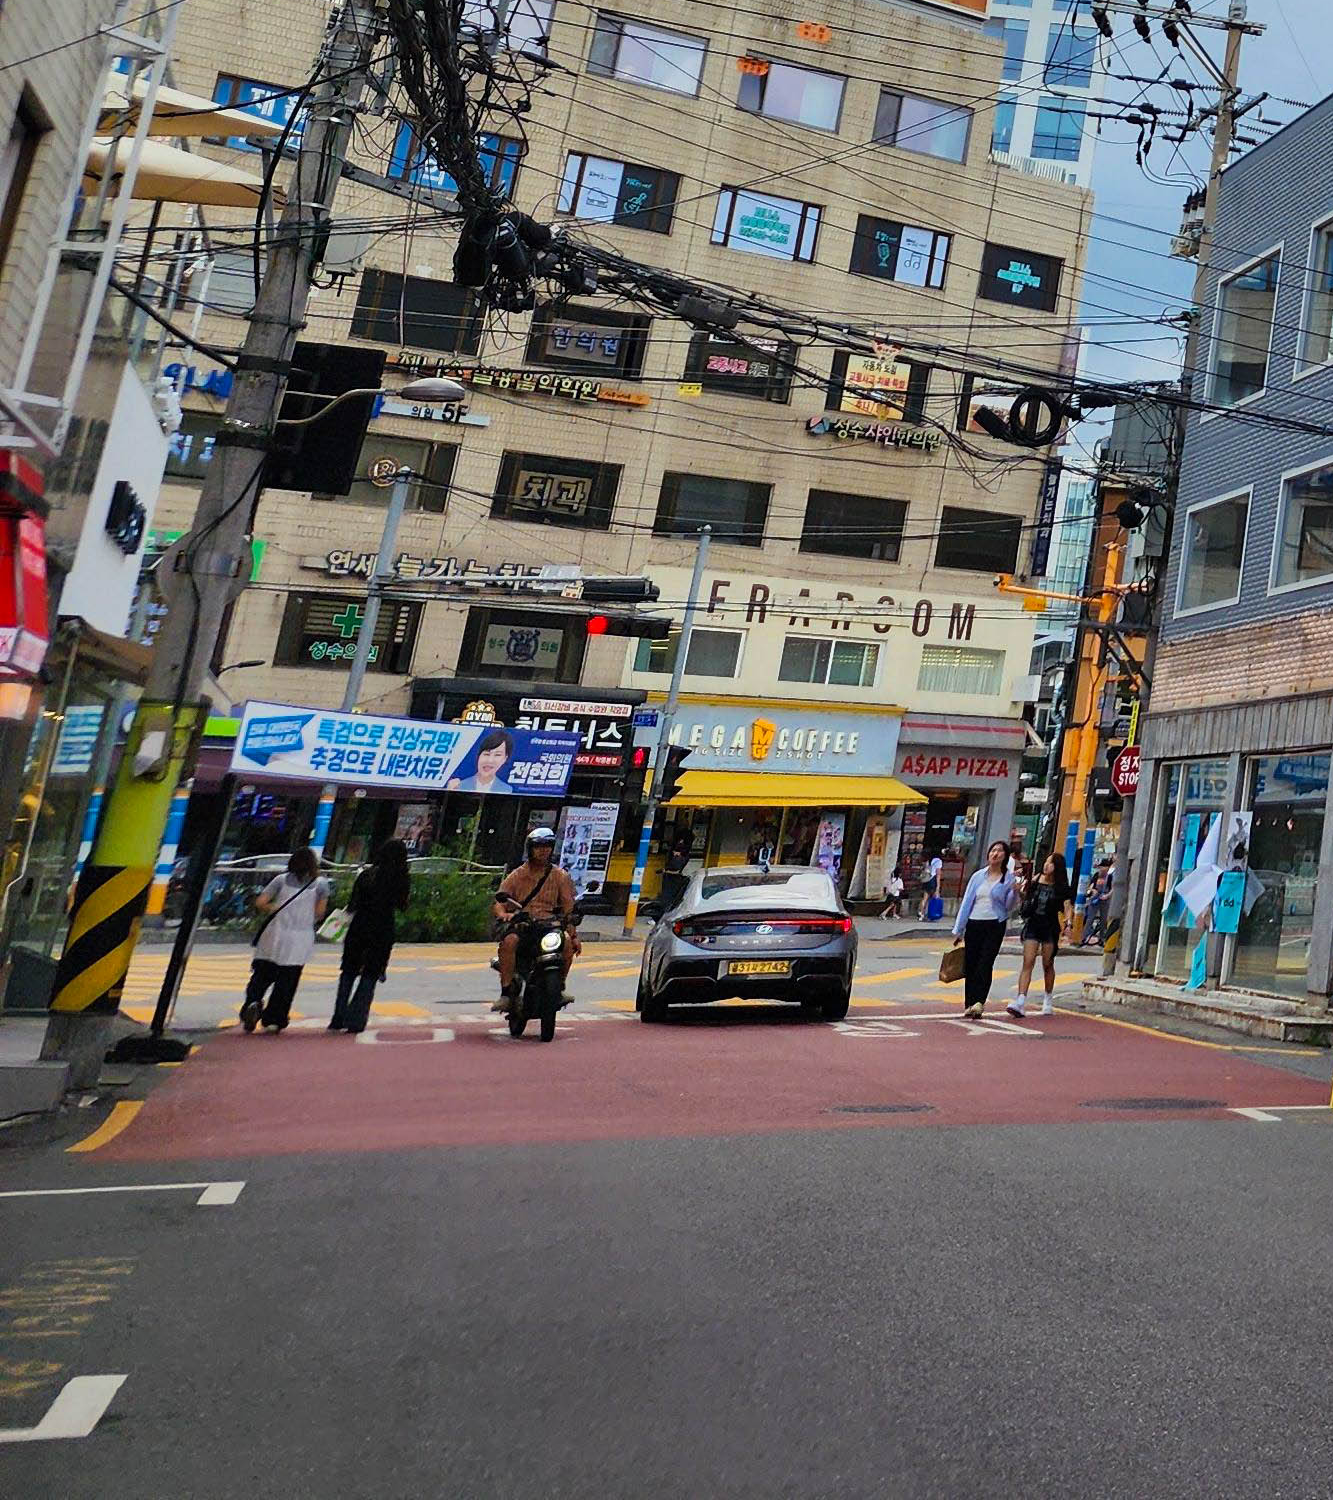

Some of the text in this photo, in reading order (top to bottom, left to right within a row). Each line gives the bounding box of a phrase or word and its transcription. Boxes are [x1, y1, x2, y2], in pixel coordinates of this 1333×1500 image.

[552, 326, 619, 357] 한의원
[441, 403, 469, 424] 5F
[523, 476, 587, 513] 치과
[317, 718, 385, 748] 특검으로
[386, 726, 461, 754] 진상규명!
[668, 722, 860, 754] MEGA COFFEE
[309, 746, 451, 781] 추경으로 내란치유!
[507, 761, 569, 787] 전현희
[901, 753, 1009, 778] A$AP PIZZA
